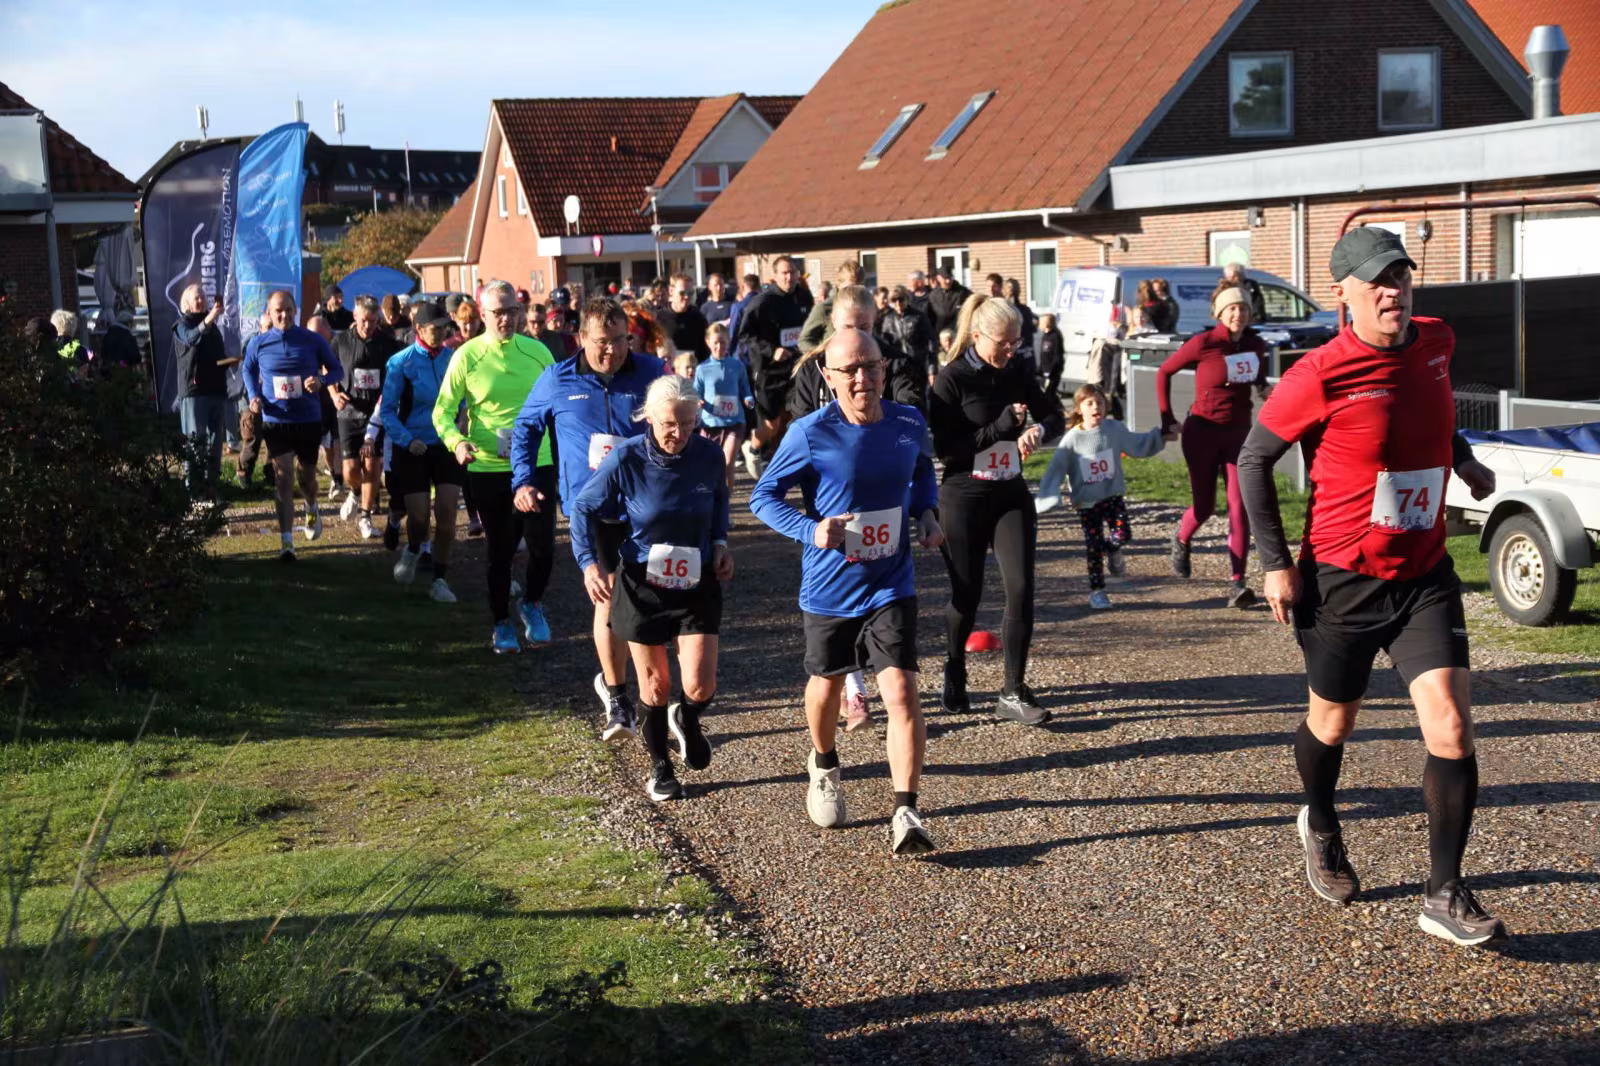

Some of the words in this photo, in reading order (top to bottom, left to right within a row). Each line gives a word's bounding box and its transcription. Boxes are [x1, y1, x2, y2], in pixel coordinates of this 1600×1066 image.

[1235, 361, 1253, 374] 51
[281, 383, 295, 393] 43
[720, 401, 734, 412] 70
[987, 452, 1011, 469] 14
[1090, 459, 1109, 475] 50
[1395, 487, 1430, 513] 74
[861, 523, 890, 547] 86
[662, 558, 688, 578] 16
